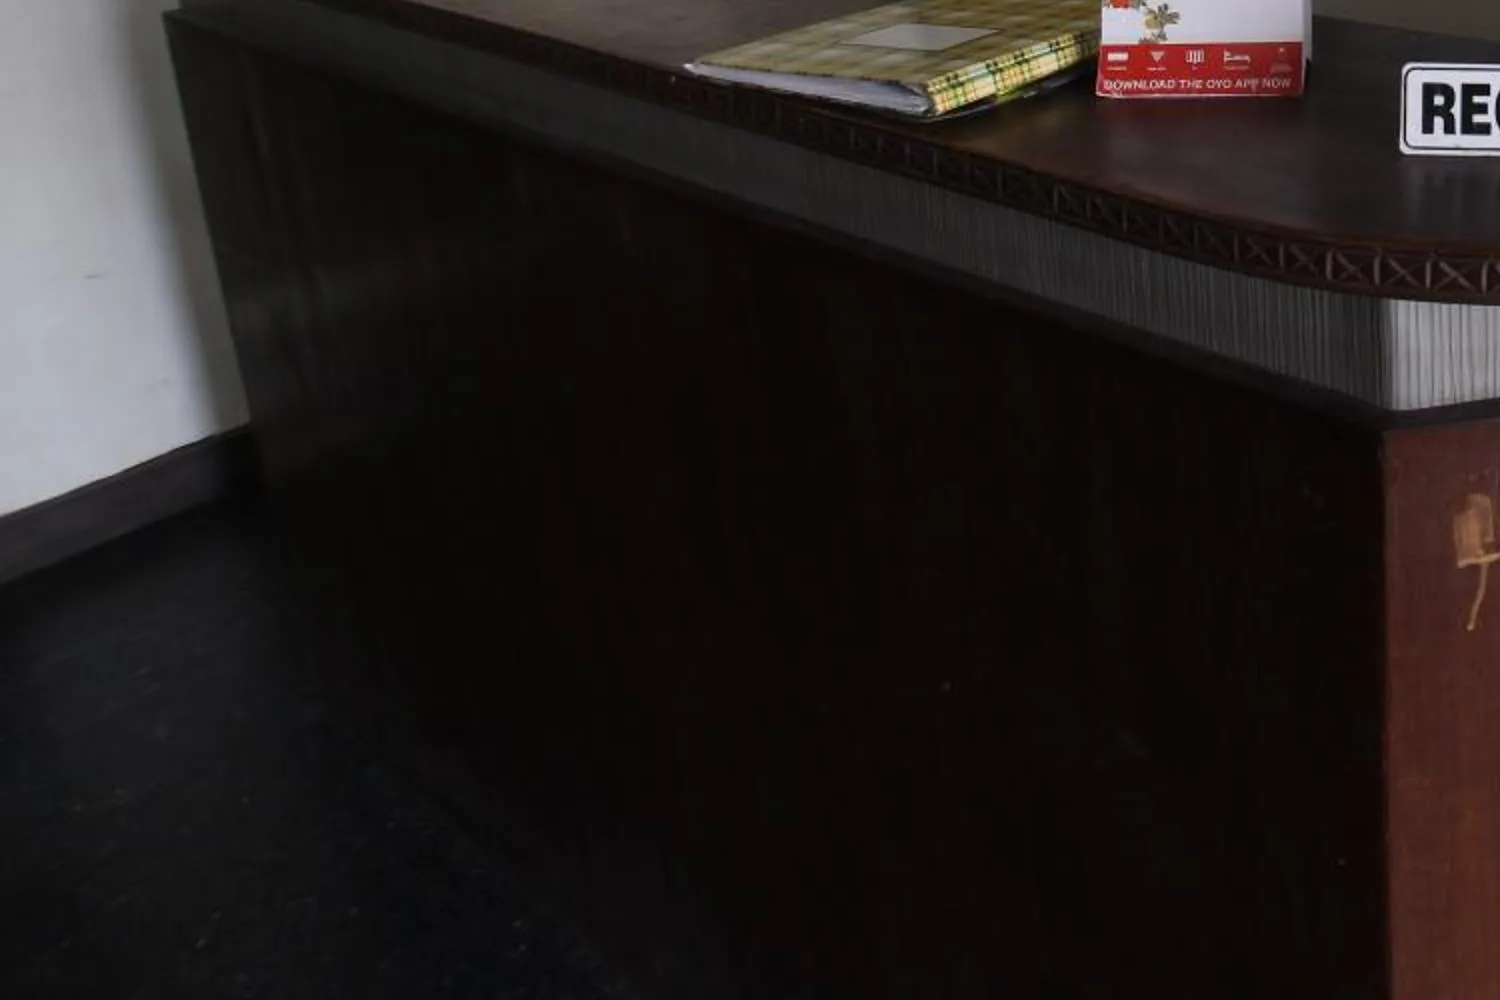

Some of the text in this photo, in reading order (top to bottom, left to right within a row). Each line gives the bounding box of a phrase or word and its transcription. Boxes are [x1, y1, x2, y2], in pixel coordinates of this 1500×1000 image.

[1104, 79, 1177, 91] DOWNLOAD
[1180, 79, 1203, 89] THE
[1206, 79, 1232, 89] OYO
[1262, 77, 1292, 88] NOW
